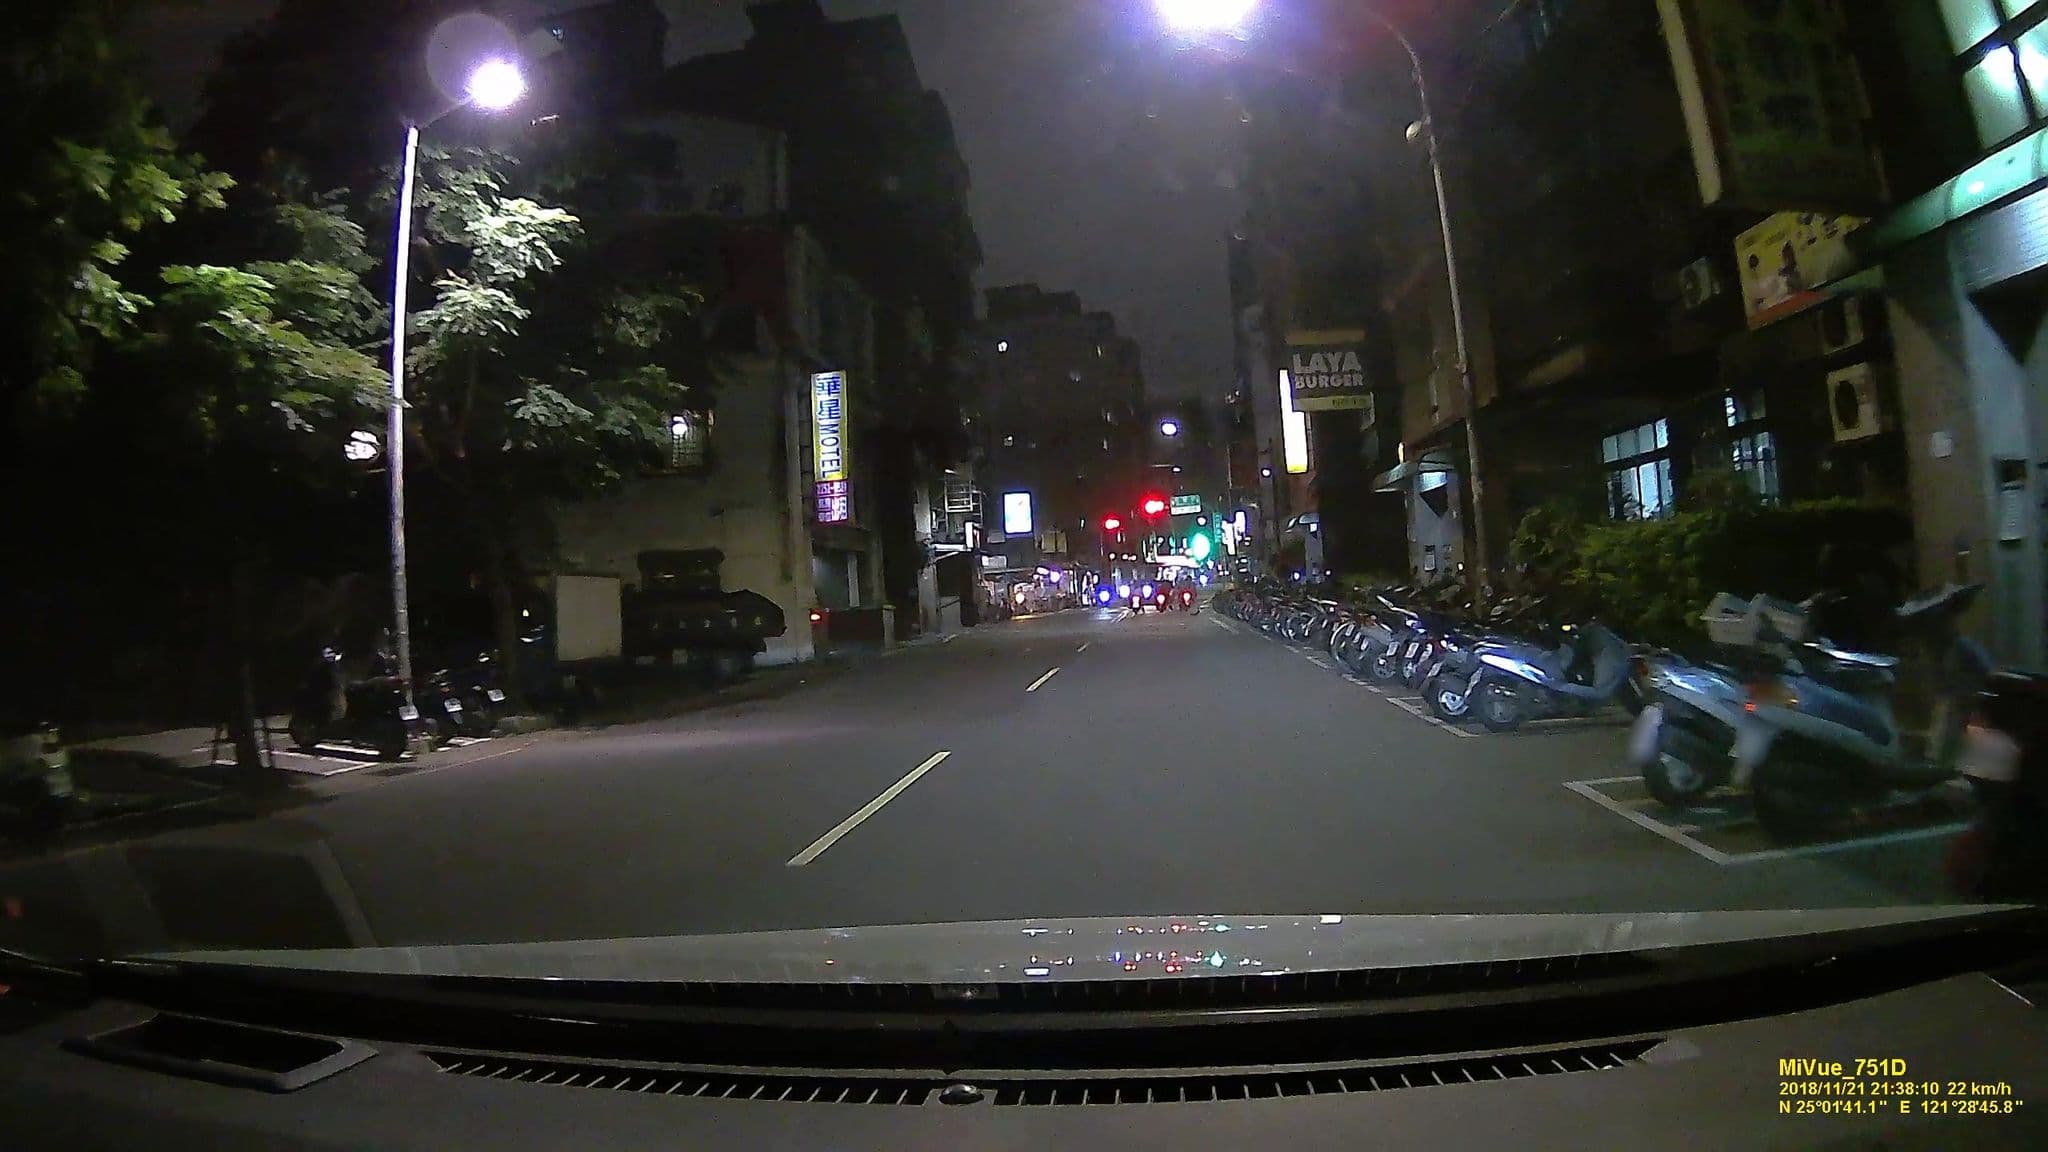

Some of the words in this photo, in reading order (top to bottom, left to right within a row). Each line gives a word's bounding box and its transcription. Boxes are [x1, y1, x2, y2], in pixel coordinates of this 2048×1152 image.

[1292, 351, 1362, 374] LAYA
[1294, 373, 1364, 389] BURGER
[819, 423, 841, 479] MOTEL
